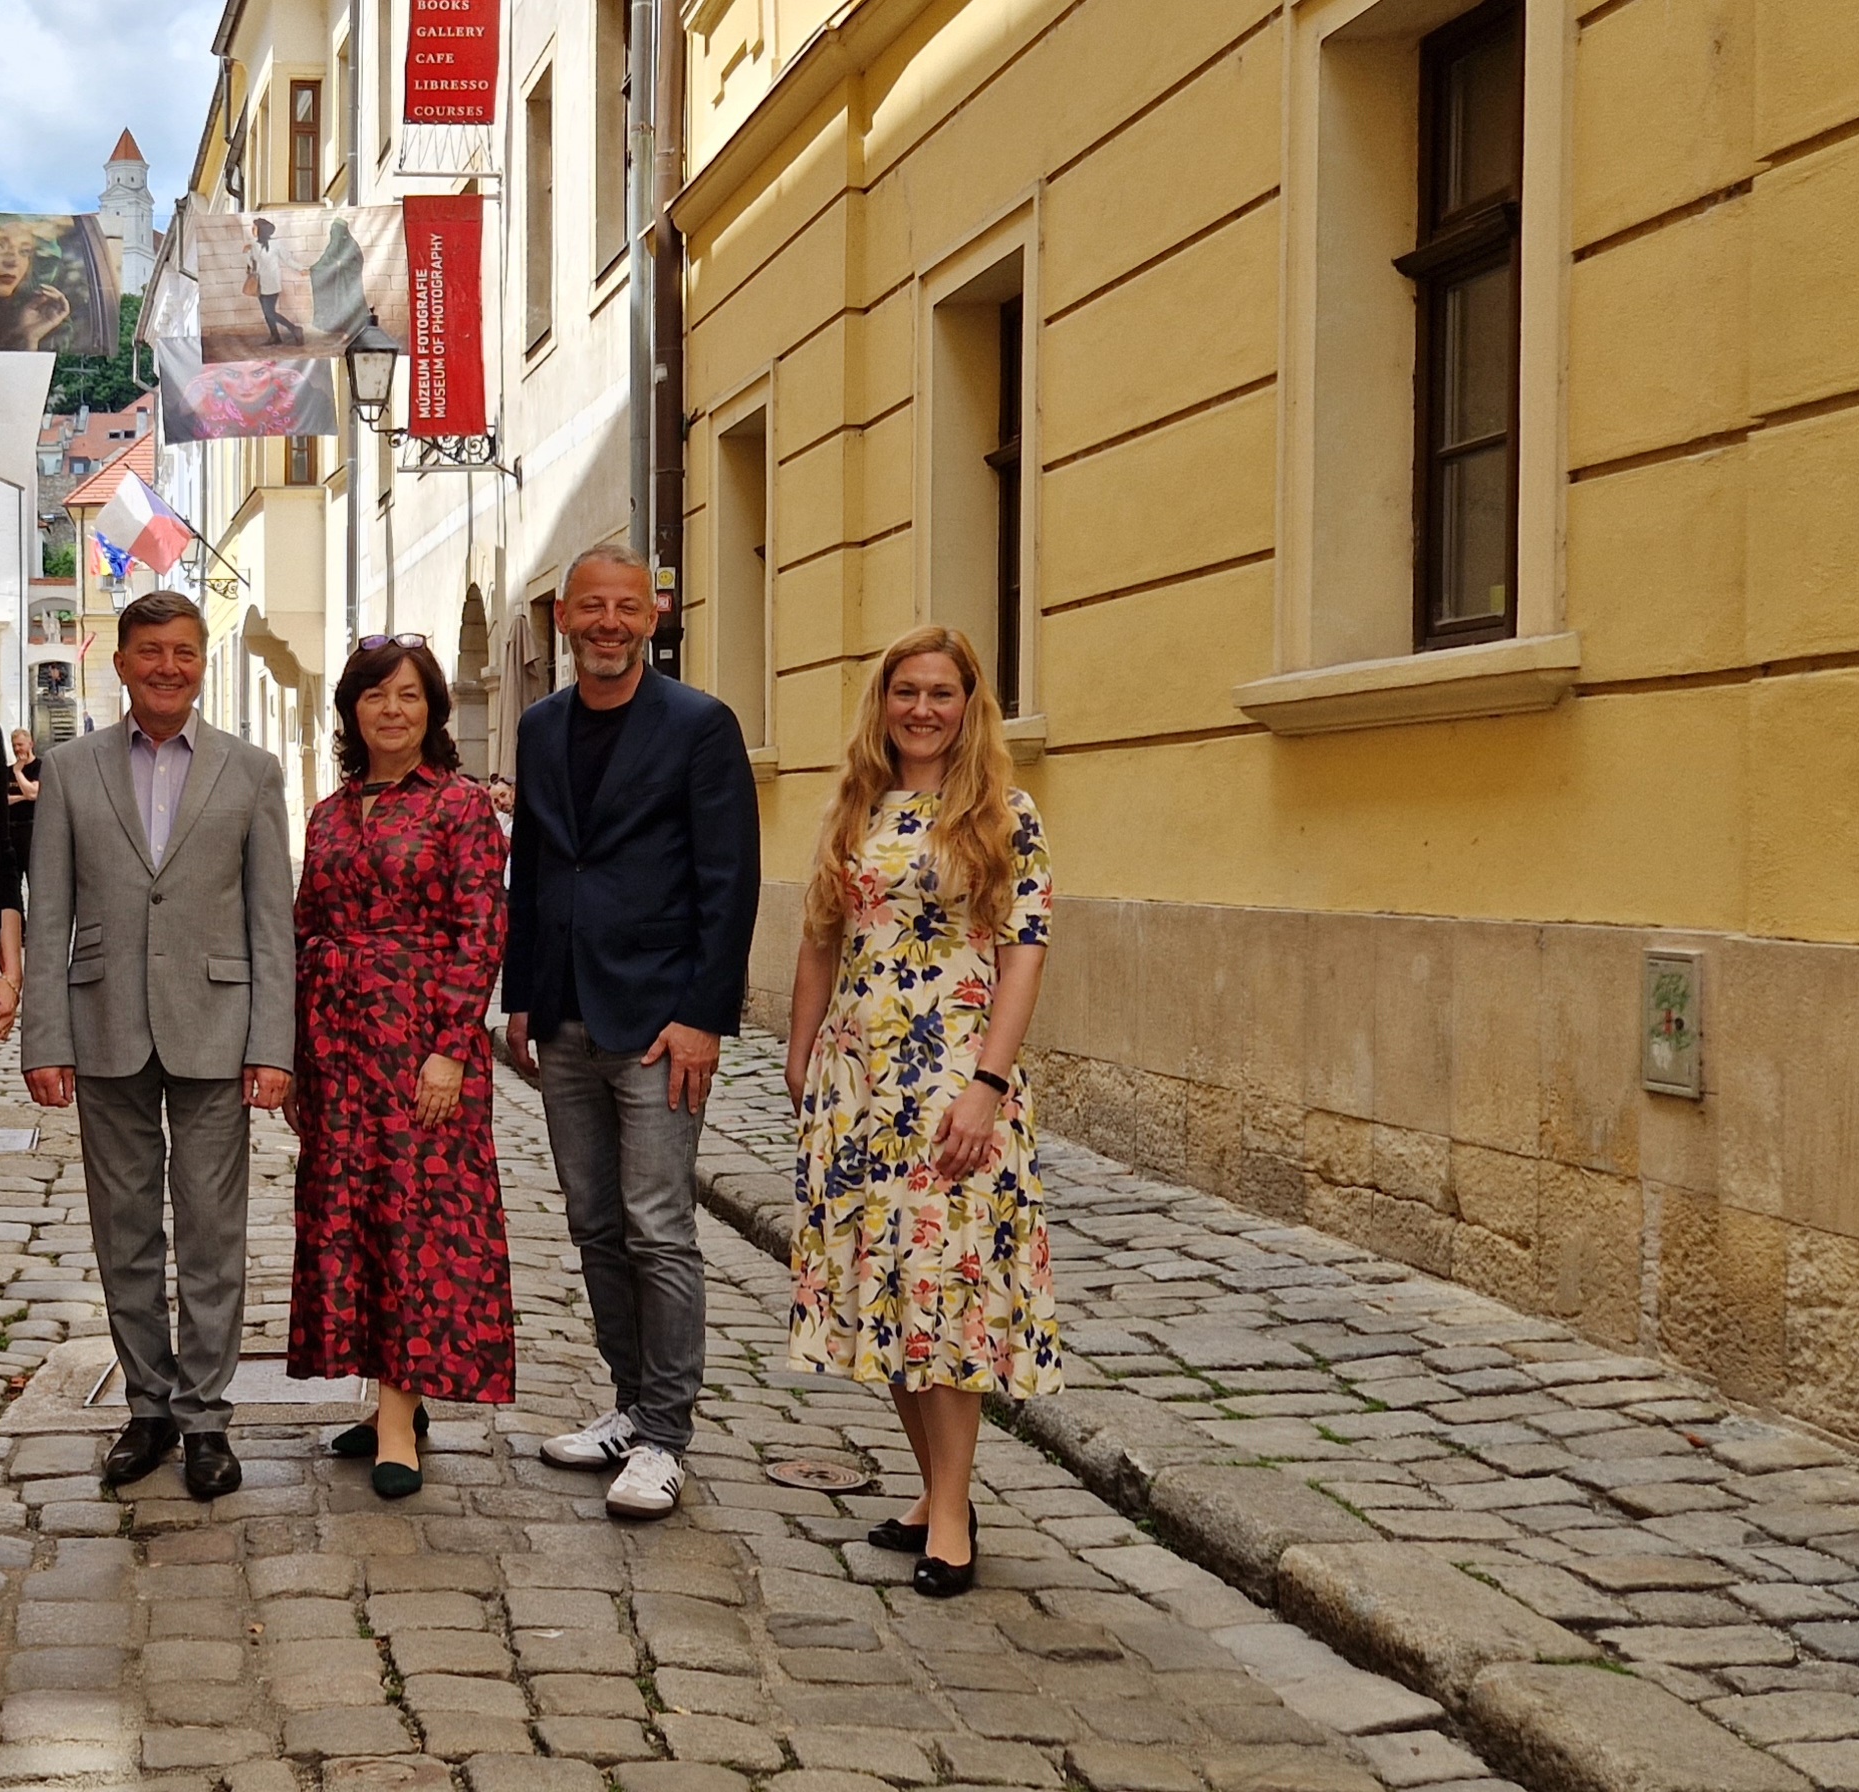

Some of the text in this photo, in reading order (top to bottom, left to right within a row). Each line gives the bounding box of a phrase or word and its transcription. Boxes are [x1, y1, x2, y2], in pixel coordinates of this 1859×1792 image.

[417, 0, 470, 11] BOOKS
[416, 26, 486, 38] GALLERY
[415, 53, 455, 64] CAFE
[414, 80, 490, 91] LIBRESSO
[414, 106, 484, 117] COURSES
[430, 233, 446, 418] MUSEUM OF PHOTOGRAPHY
[415, 268, 431, 419] MÚZEUM FOTOGRAFIE
